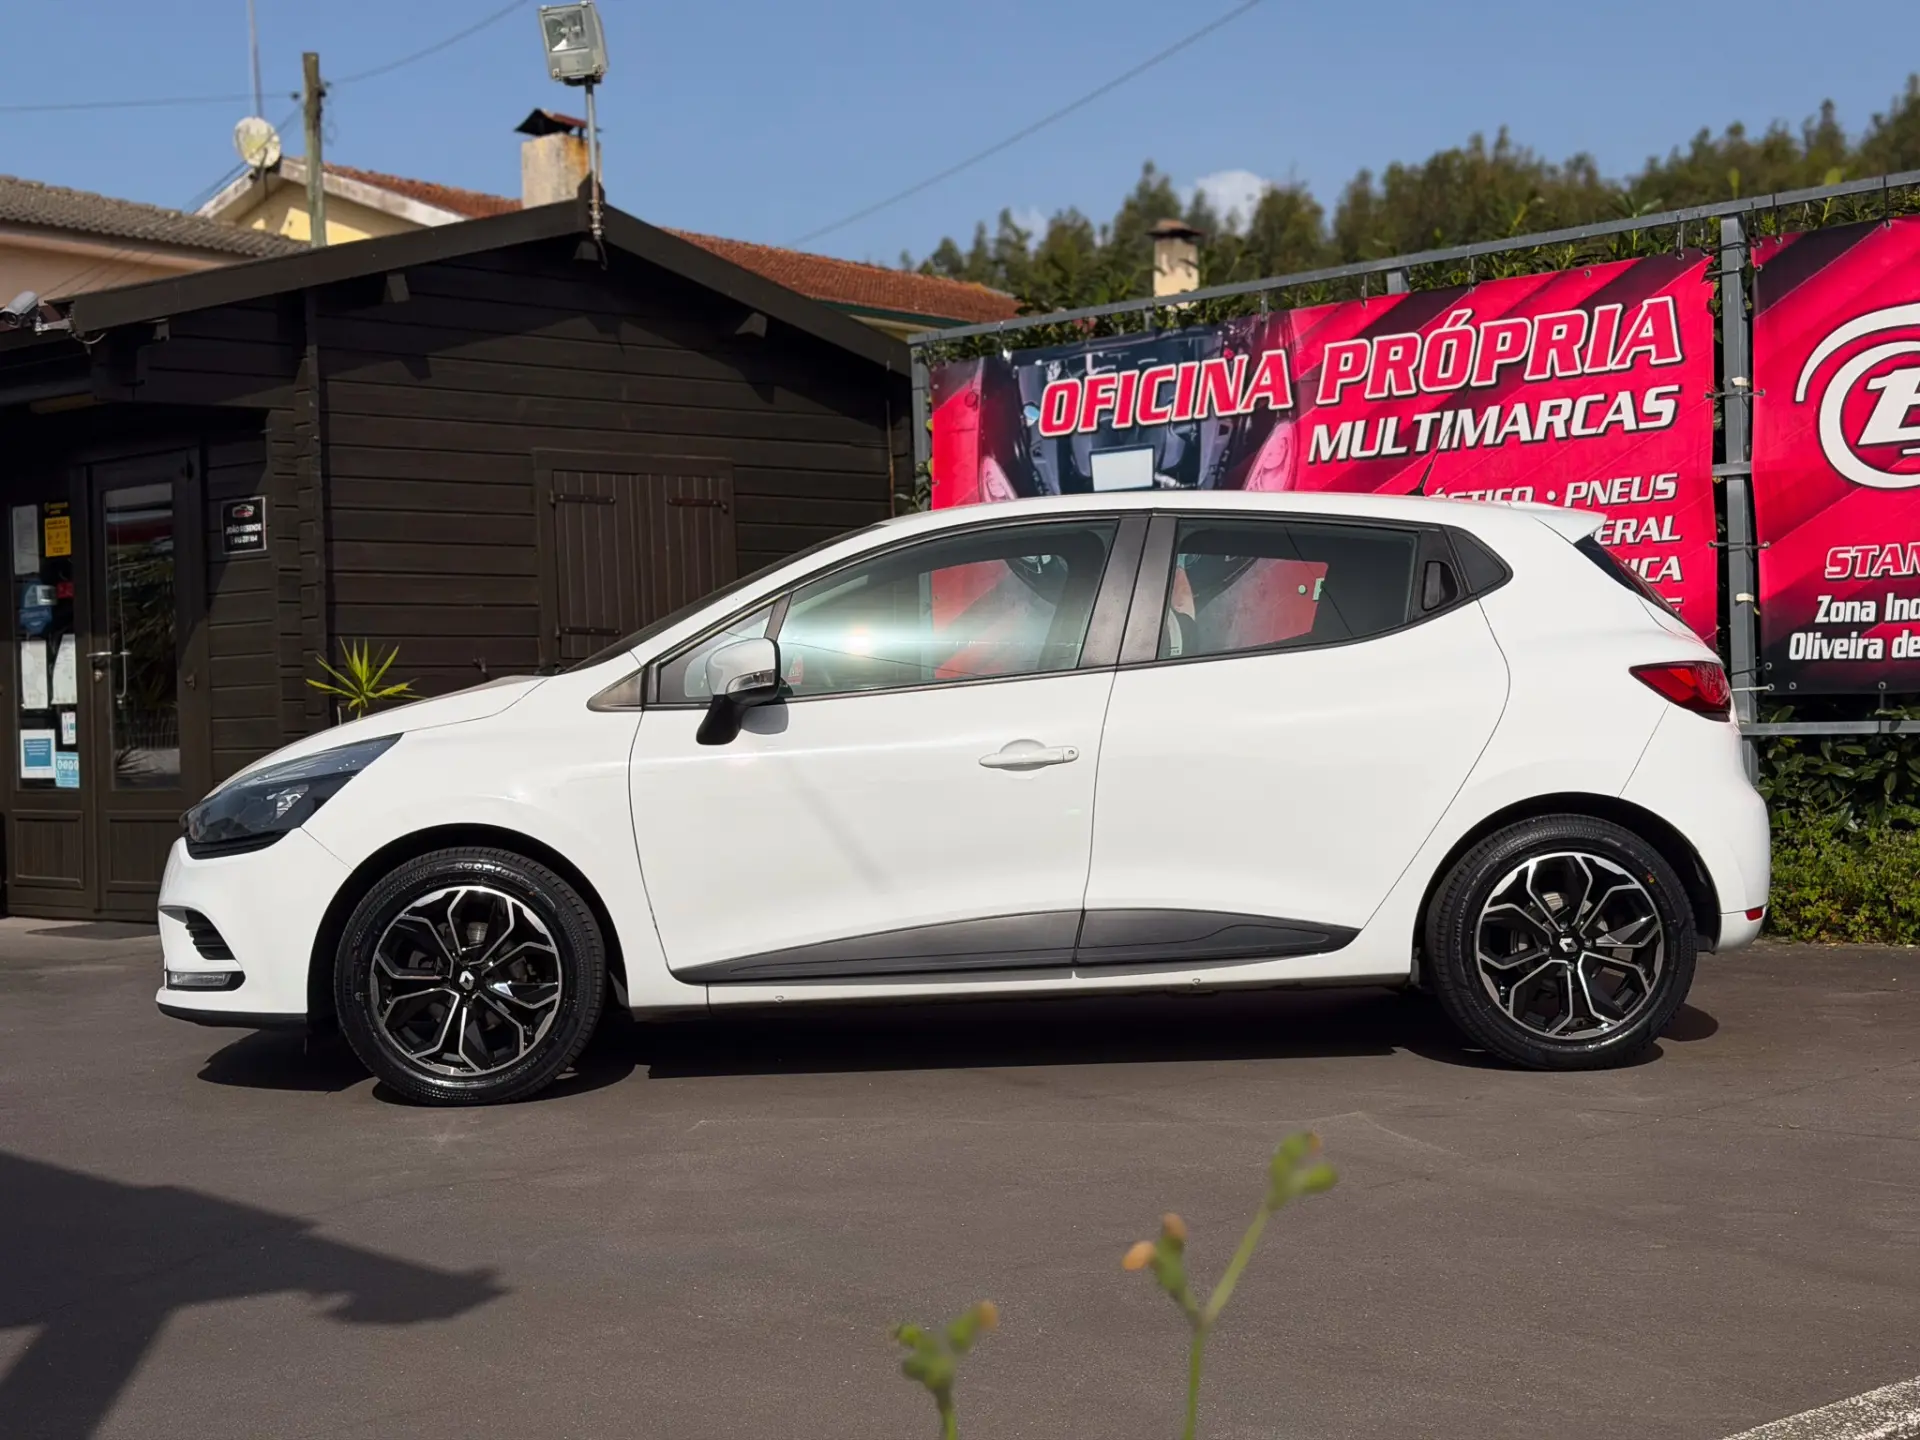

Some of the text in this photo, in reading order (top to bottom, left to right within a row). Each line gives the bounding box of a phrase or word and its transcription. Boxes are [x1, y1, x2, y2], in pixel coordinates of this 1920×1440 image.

[1039, 296, 1683, 437] OFICINA PRÓPRIA
[1307, 384, 1681, 463] MULTIMARCAS
[1563, 473, 1679, 508] PNEUS
[1591, 515, 1682, 546] ERAL
[1623, 555, 1683, 584] ICA
[1814, 594, 1877, 624] Zona
[1788, 629, 1920, 661] Oliveira de
